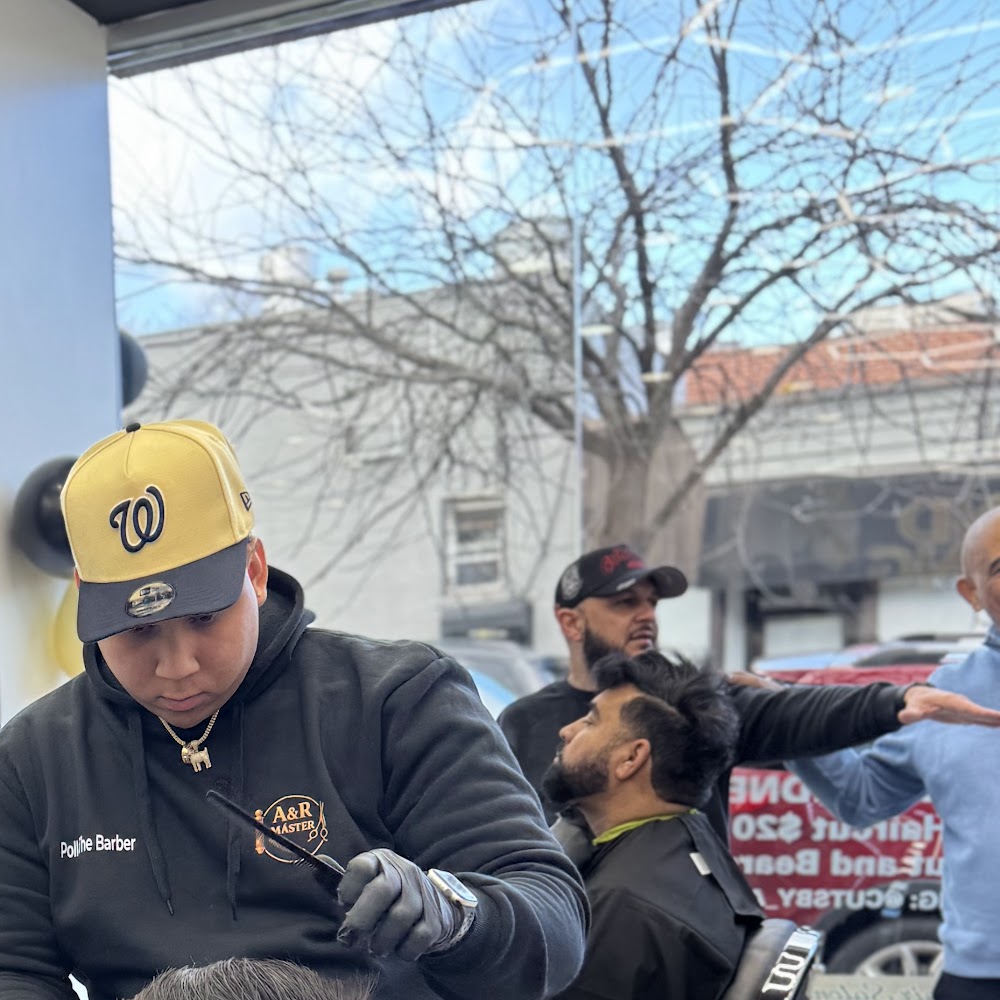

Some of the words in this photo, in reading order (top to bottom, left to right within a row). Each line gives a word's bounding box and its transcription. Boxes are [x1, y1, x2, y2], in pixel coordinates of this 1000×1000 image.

[109, 484, 166, 553] W
[272, 801, 313, 825] A&R
[60, 841, 79, 859] Poll
[96, 834, 137, 851] Barber
